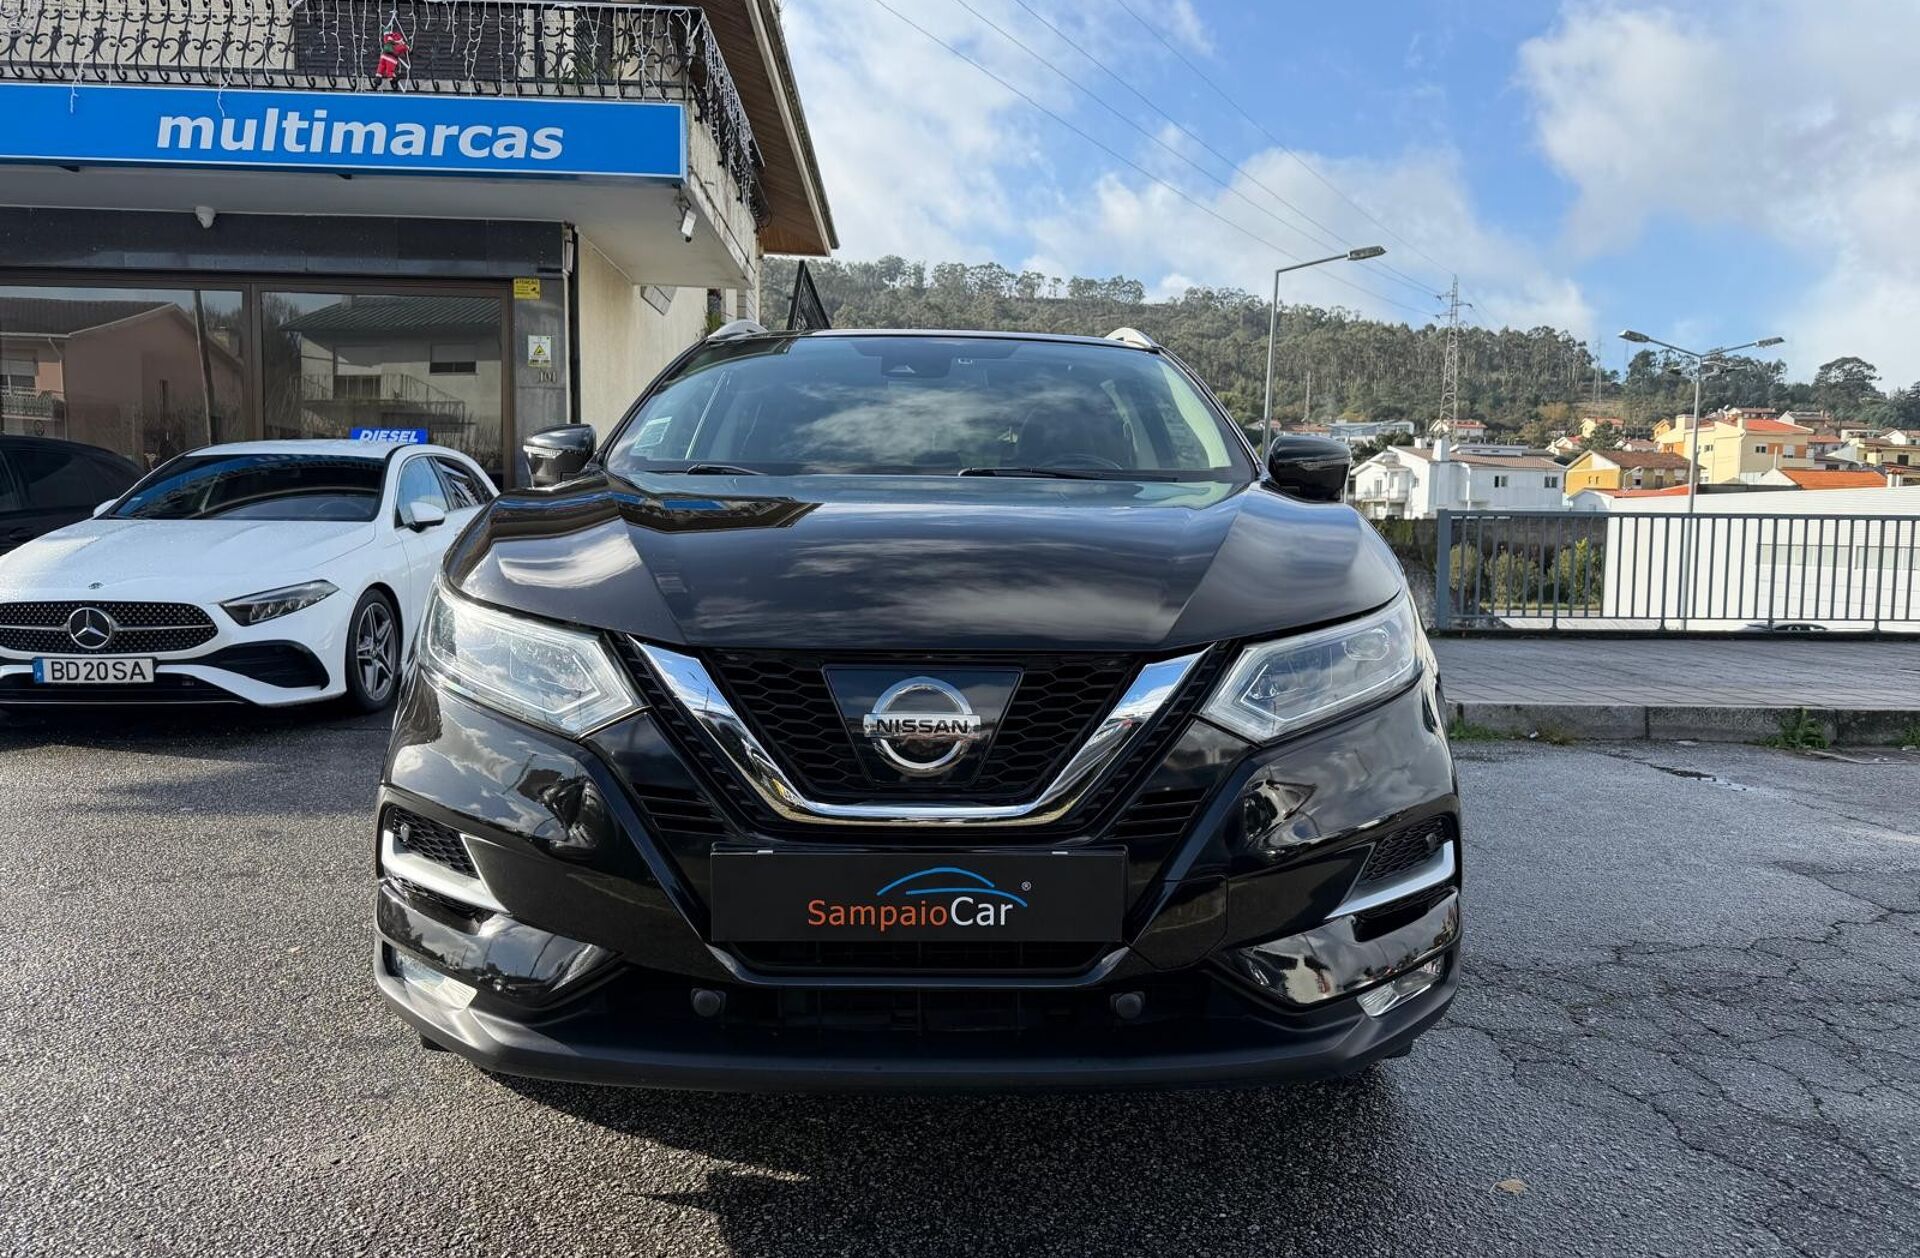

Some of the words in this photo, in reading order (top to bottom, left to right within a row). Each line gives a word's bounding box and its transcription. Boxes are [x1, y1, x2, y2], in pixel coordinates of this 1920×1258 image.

[156, 107, 564, 160] multimarcas
[360, 430, 418, 443] DIESEL
[876, 719, 968, 734] NISSAN
[808, 897, 1013, 931] SampaioCar
